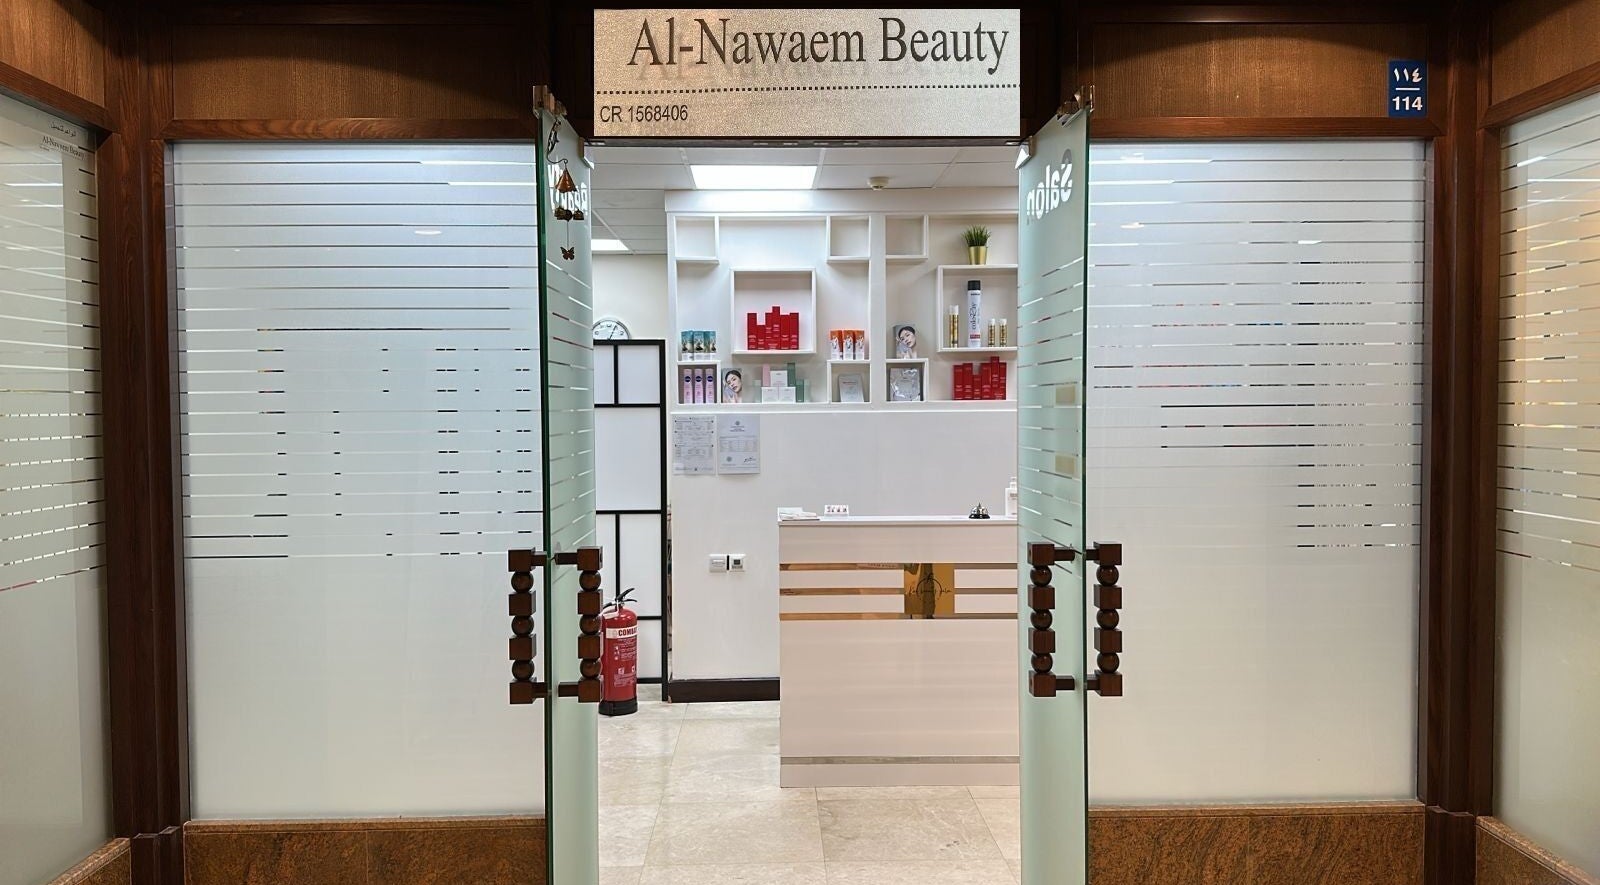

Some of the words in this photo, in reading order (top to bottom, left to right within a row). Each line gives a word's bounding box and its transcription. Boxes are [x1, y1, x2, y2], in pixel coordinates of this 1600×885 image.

[627, 17, 867, 66] Al-Nawaem
[878, 17, 1009, 75] Beauty
[1394, 68, 1422, 82] ١١٤
[1392, 96, 1423, 110] 114
[600, 105, 623, 122] CR
[628, 104, 689, 122] 1568406
